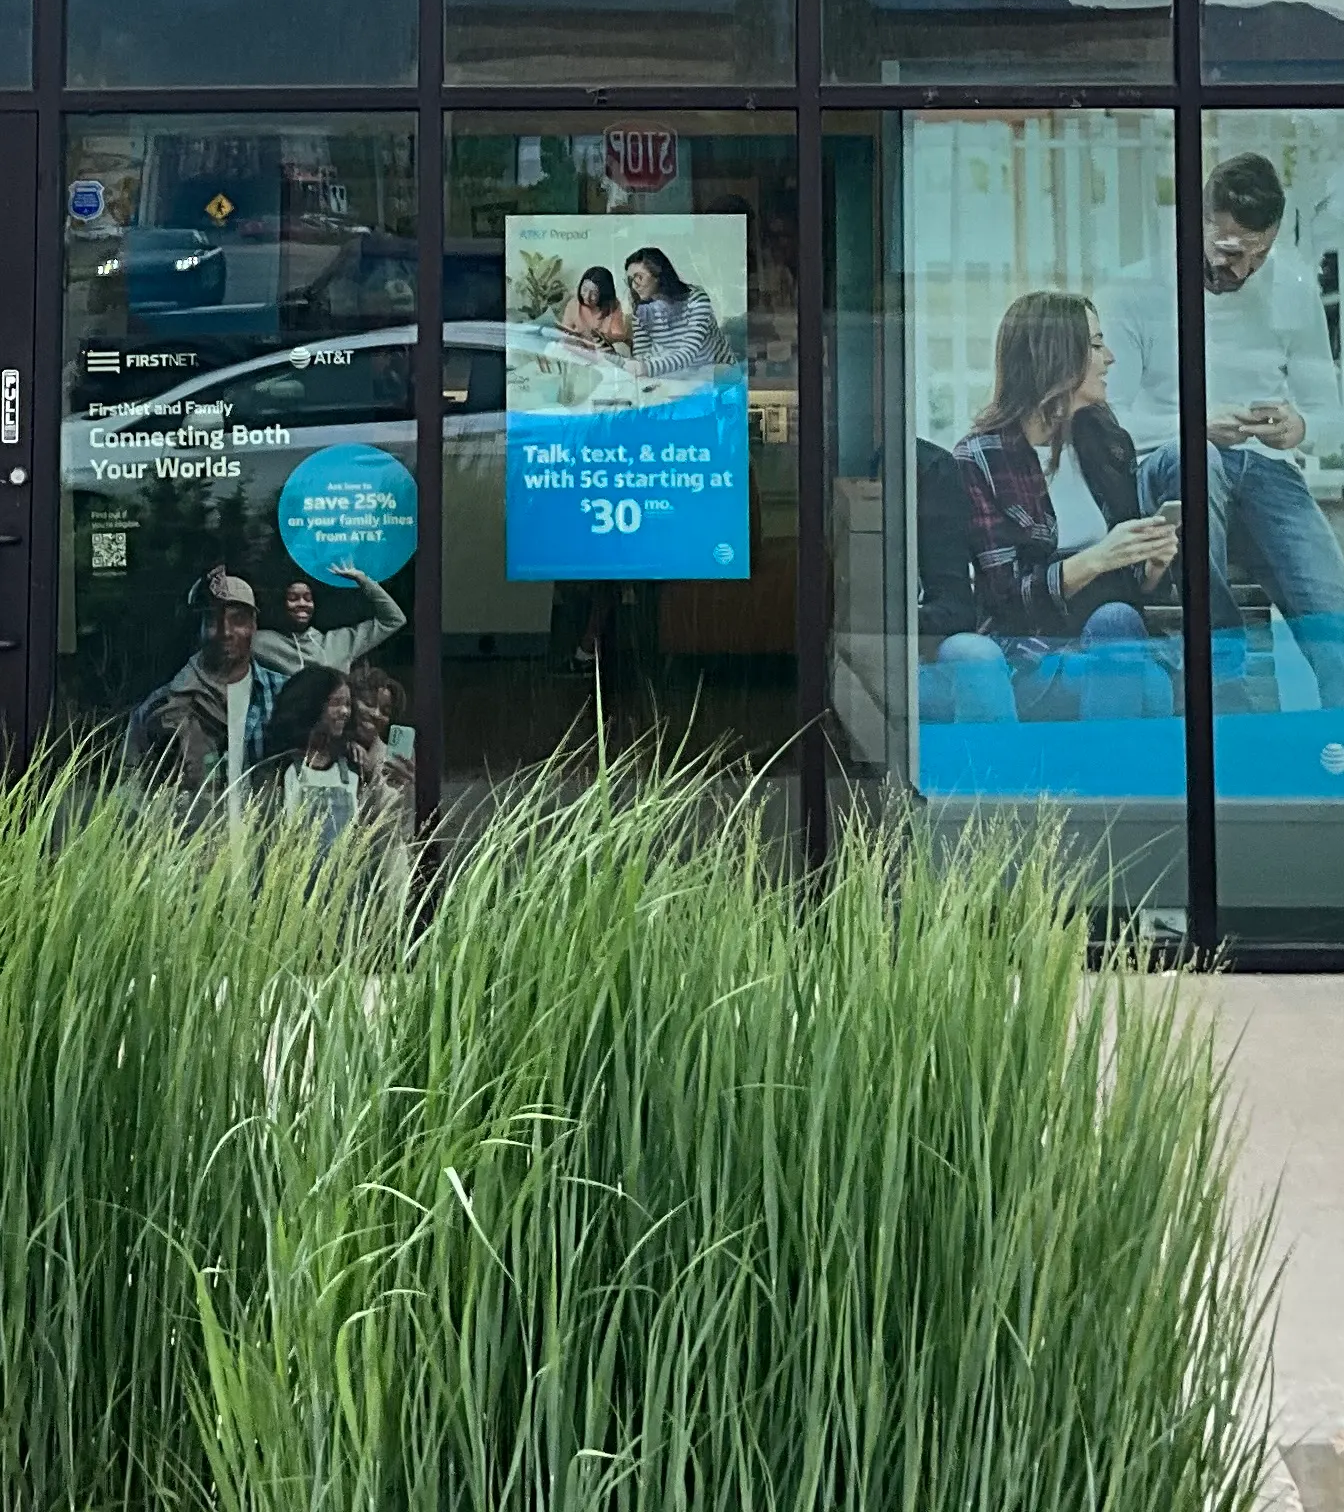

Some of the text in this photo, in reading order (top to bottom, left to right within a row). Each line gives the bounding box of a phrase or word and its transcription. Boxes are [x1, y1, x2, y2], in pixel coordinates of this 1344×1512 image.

[126, 353, 197, 368] FIRSTNET
[313, 350, 355, 365] AT&T
[4, 375, 16, 425] PULL
[89, 400, 234, 417] FirstNet and Family
[89, 424, 291, 450] Connecting Both
[523, 443, 711, 466] Talk, text, & data
[90, 457, 241, 480] Your Worlds
[524, 469, 734, 493] with 5G starting at
[304, 493, 397, 509] save 25%
[307, 517, 336, 530] your
[340, 513, 379, 528] family
[316, 530, 347, 542] from
